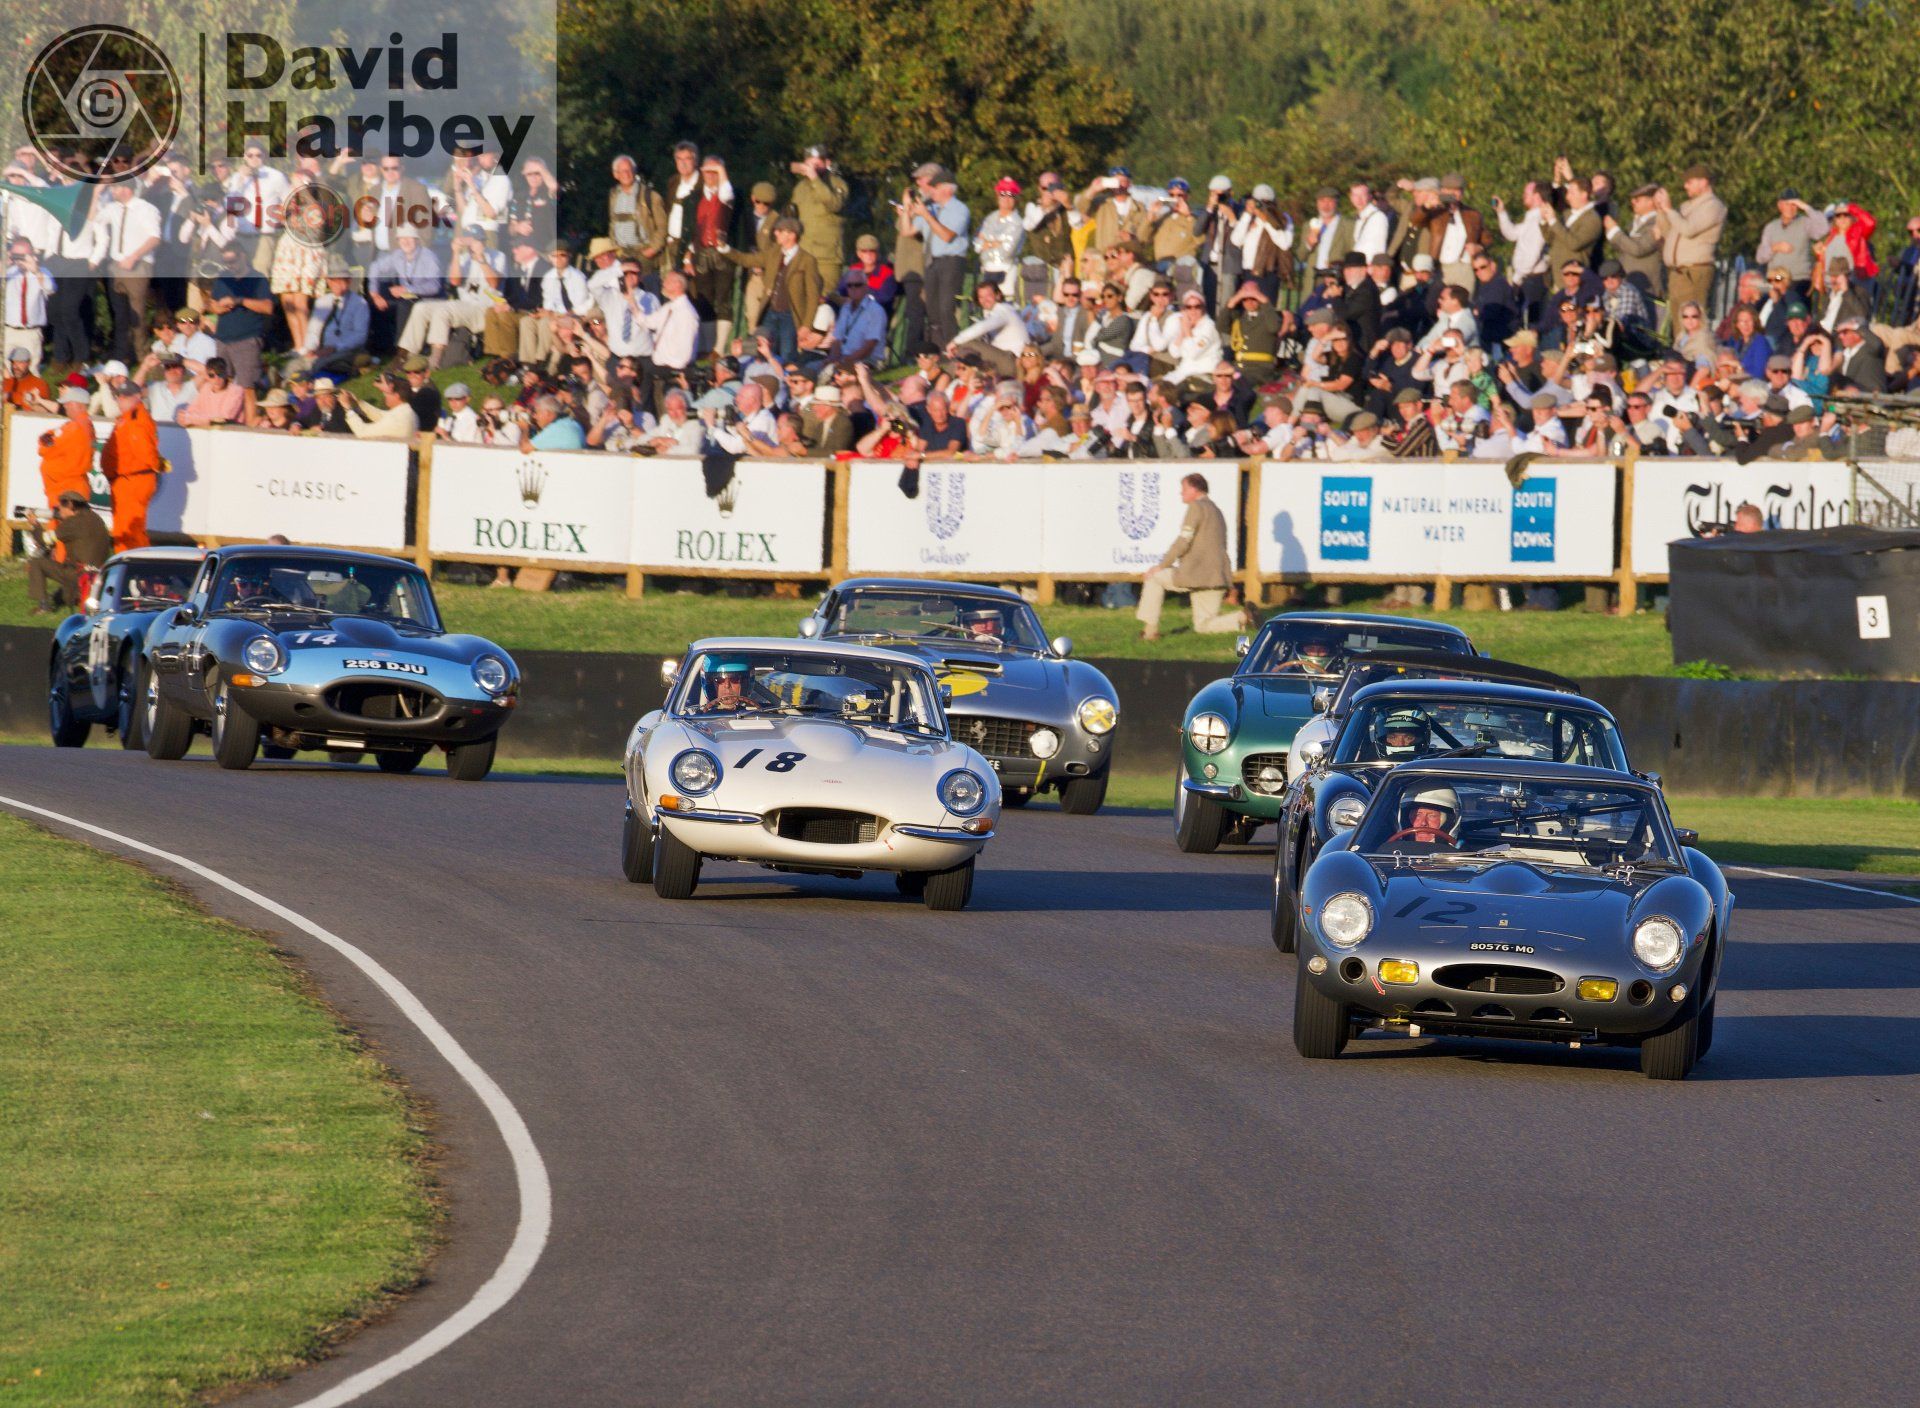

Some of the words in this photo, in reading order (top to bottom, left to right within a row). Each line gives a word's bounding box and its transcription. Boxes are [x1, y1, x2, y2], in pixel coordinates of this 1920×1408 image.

[1324, 490, 1368, 507] SOUTH
[1382, 498, 1442, 514] NATURAL
[1448, 498, 1503, 514] MINERAL
[1514, 491, 1553, 508] SOUTH
[474, 517, 589, 554] ROLEX
[1423, 525, 1466, 542] WATER
[676, 529, 778, 563] ROLEX
[1867, 607, 1879, 628] 3
[294, 632, 339, 645] 14
[346, 659, 381, 669] 256
[386, 661, 425, 674] DJU
[733, 748, 807, 773] 18
[1393, 896, 1478, 924] 12
